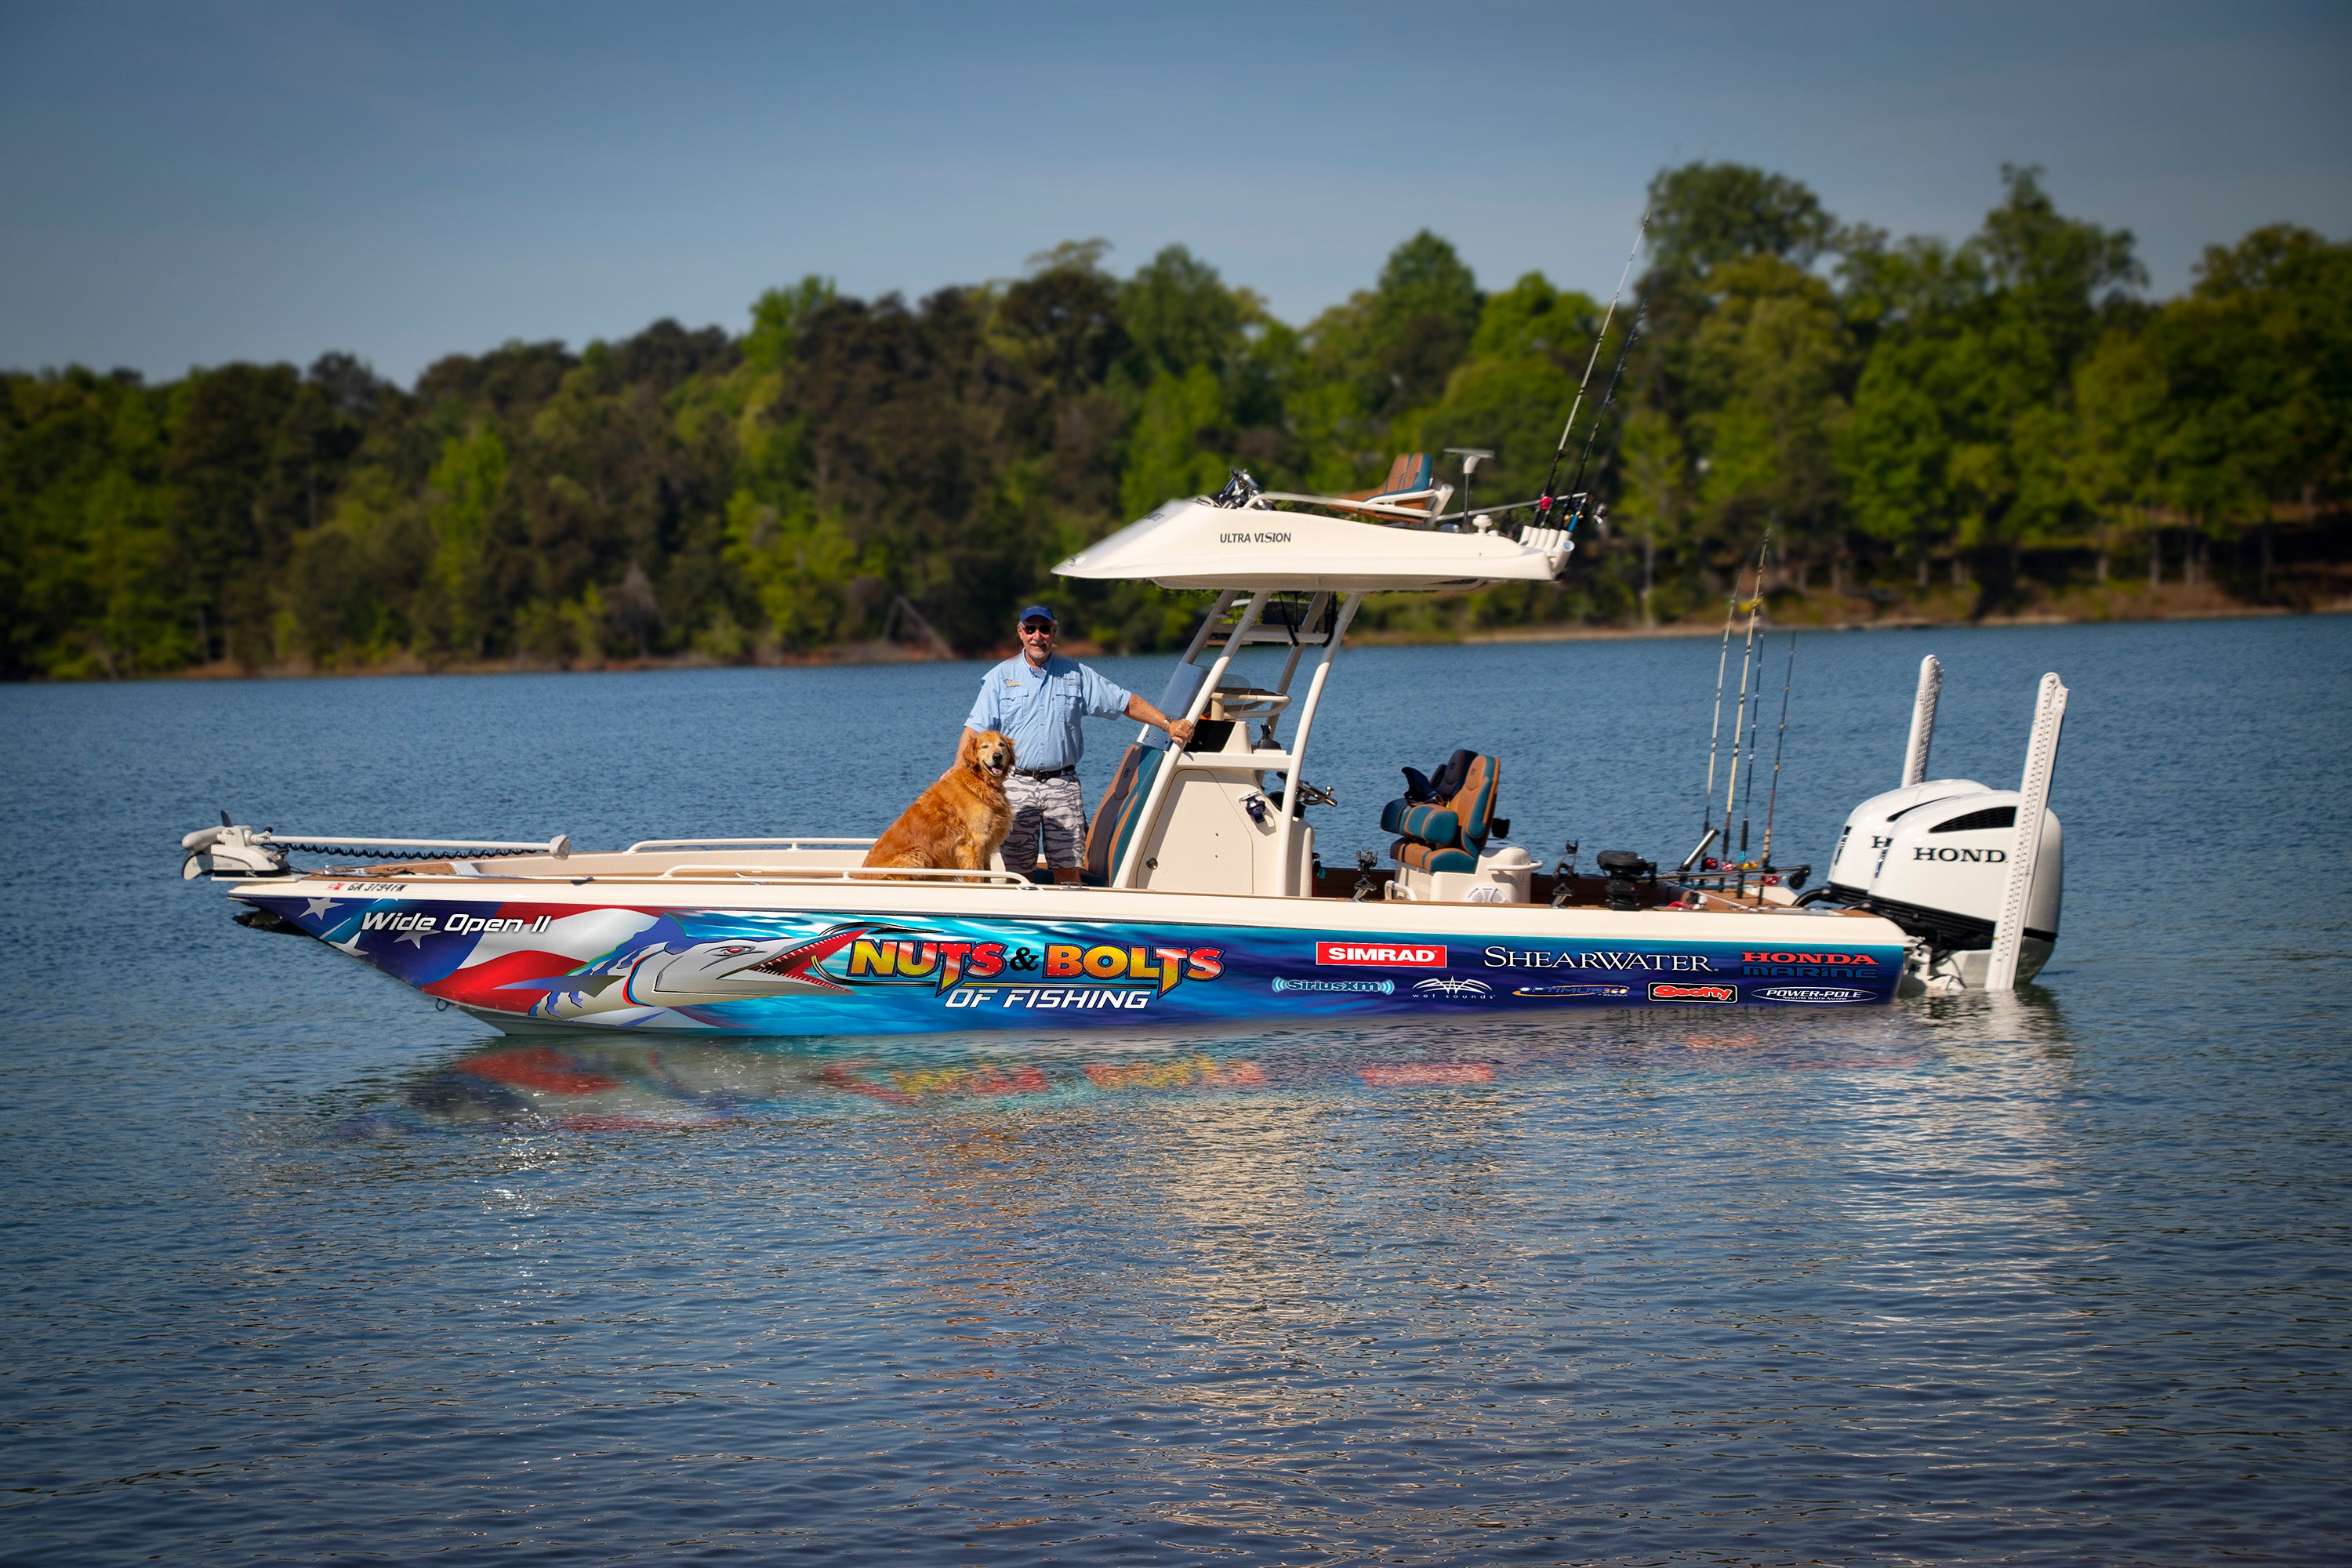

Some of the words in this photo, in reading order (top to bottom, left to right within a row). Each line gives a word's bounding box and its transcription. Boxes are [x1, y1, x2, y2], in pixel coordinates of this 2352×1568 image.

[1220, 532, 1251, 543] ULTRA
[1254, 532, 1291, 543] VISION
[1913, 847, 2009, 863] HOND
[347, 883, 365, 891] GA
[361, 912, 437, 931] Wide
[444, 913, 524, 936] Open
[530, 915, 552, 933] II
[1327, 946, 1436, 963] SIMRAD
[1483, 946, 1714, 972] SHEARWATER
[1740, 951, 1879, 965] HONDA
[846, 938, 1008, 997] NUTS
[1009, 946, 1040, 971] &
[1042, 942, 1225, 999] BOLTS
[945, 989, 999, 1009] OF
[1002, 989, 1152, 1010] FISHING
[1766, 989, 1863, 999] POWER-POLE
